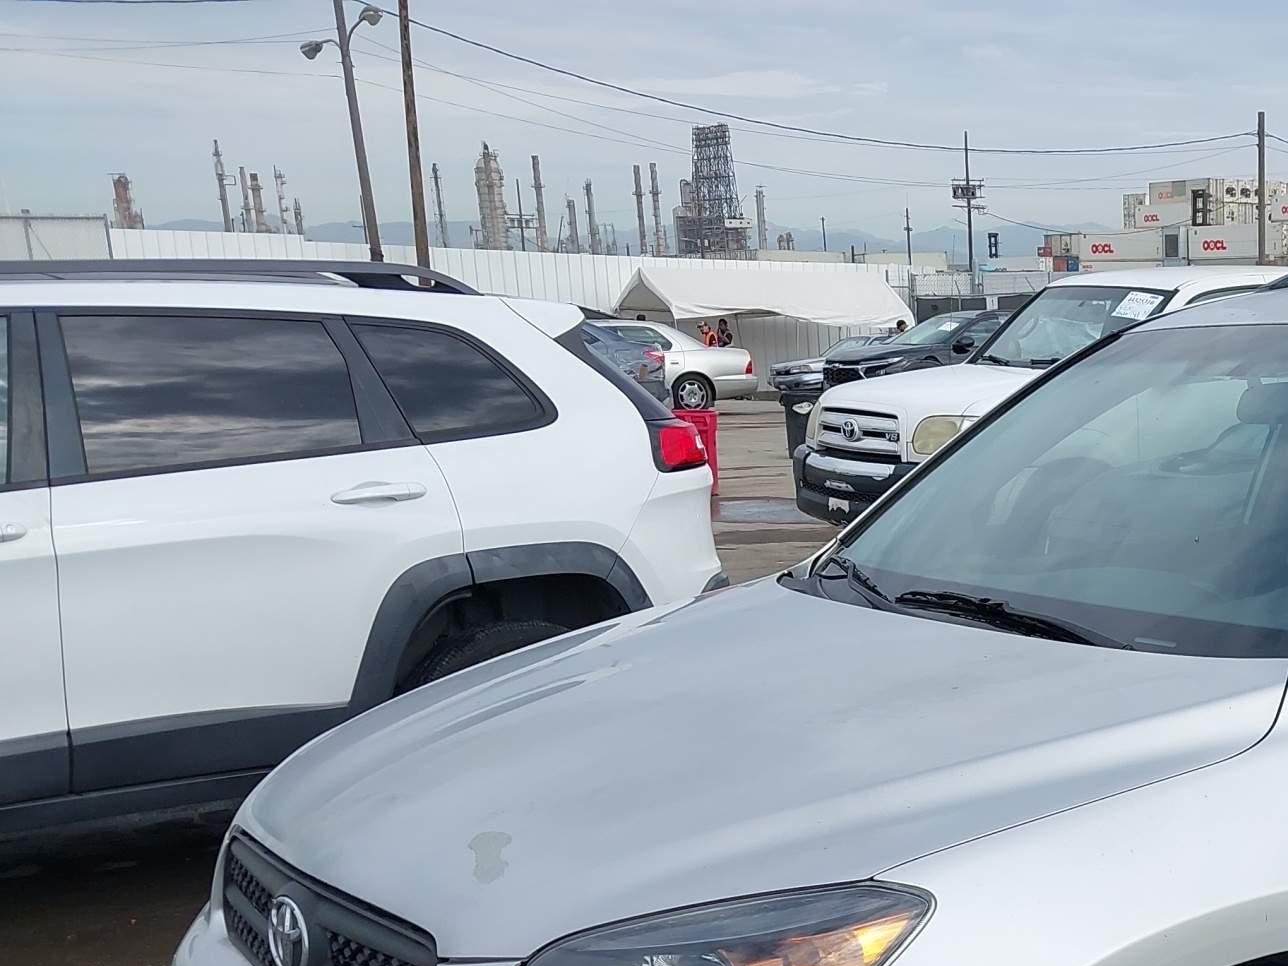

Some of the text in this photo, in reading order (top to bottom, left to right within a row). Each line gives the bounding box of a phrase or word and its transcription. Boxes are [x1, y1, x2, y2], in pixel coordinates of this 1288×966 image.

[1144, 214, 1160, 222] OOCL
[1091, 243, 1114, 254] OOCL
[1202, 240, 1227, 250] OOCL
[885, 432, 898, 441] V8
